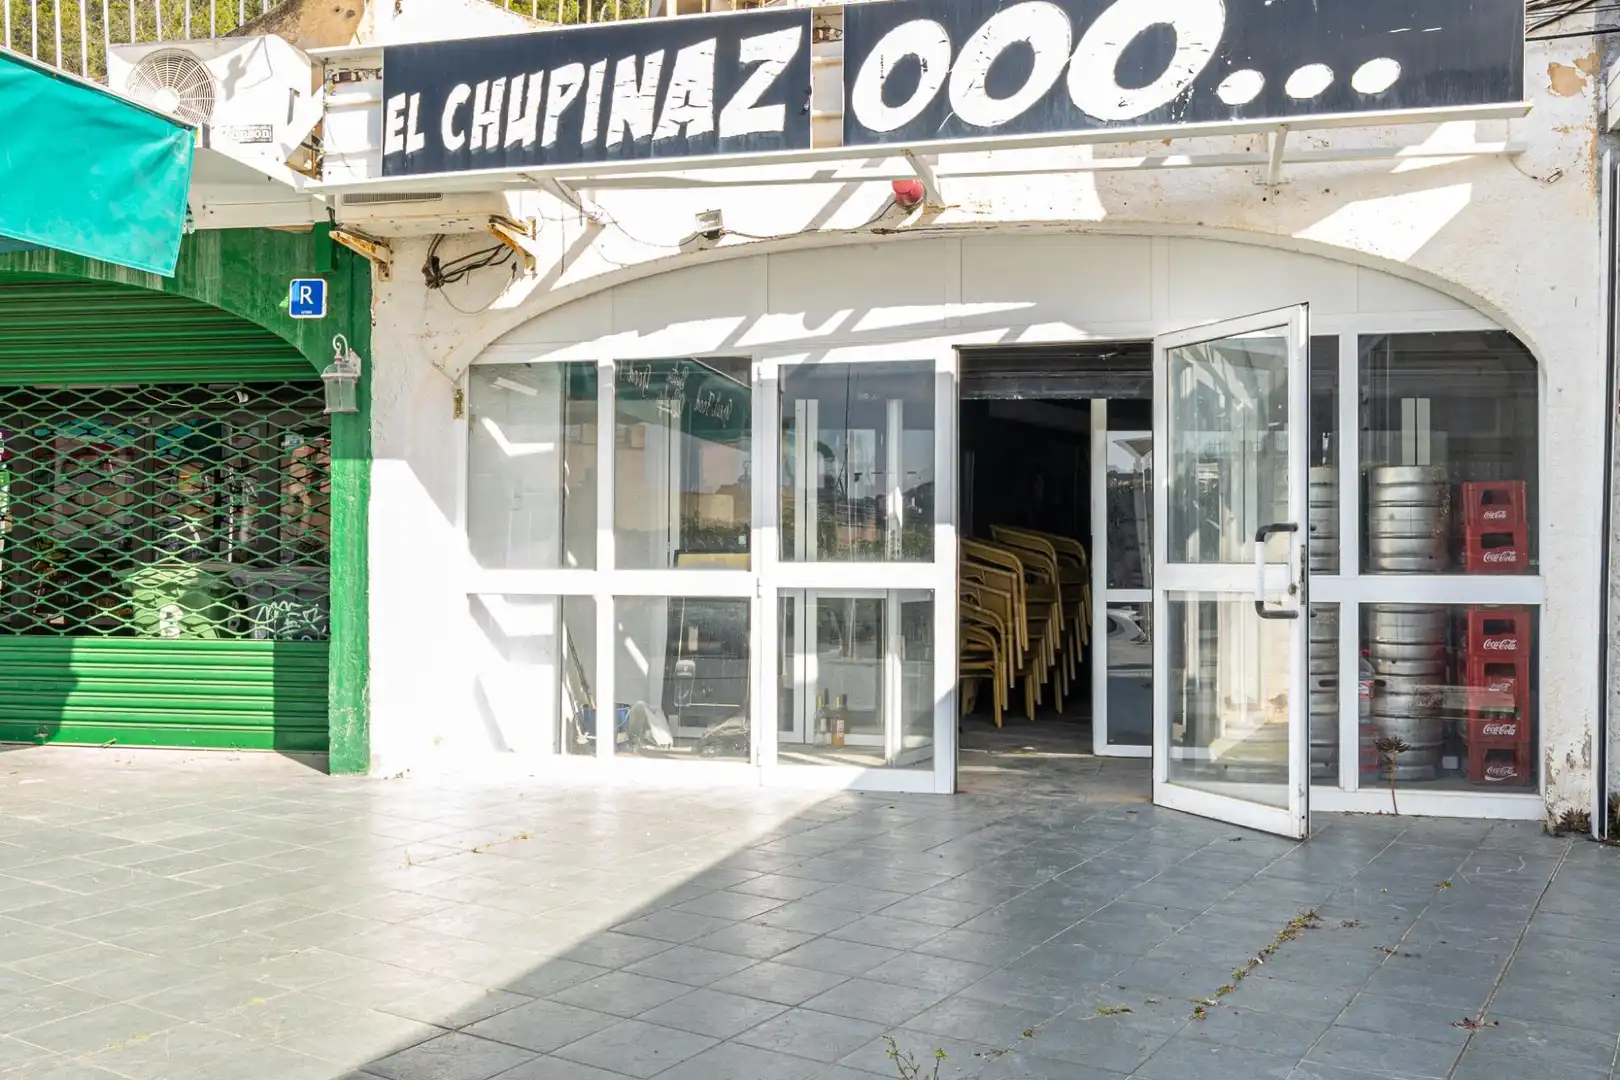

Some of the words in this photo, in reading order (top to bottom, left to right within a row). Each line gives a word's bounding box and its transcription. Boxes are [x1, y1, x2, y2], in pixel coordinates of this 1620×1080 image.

[384, 92, 425, 155] EL
[441, 25, 802, 151] CHUPINAZ
[299, 285, 314, 305] R
[1483, 551, 1516, 562] Coca-Cola
[1483, 639, 1517, 650] Coca-Cola
[1483, 724, 1516, 735] Coca-Cola
